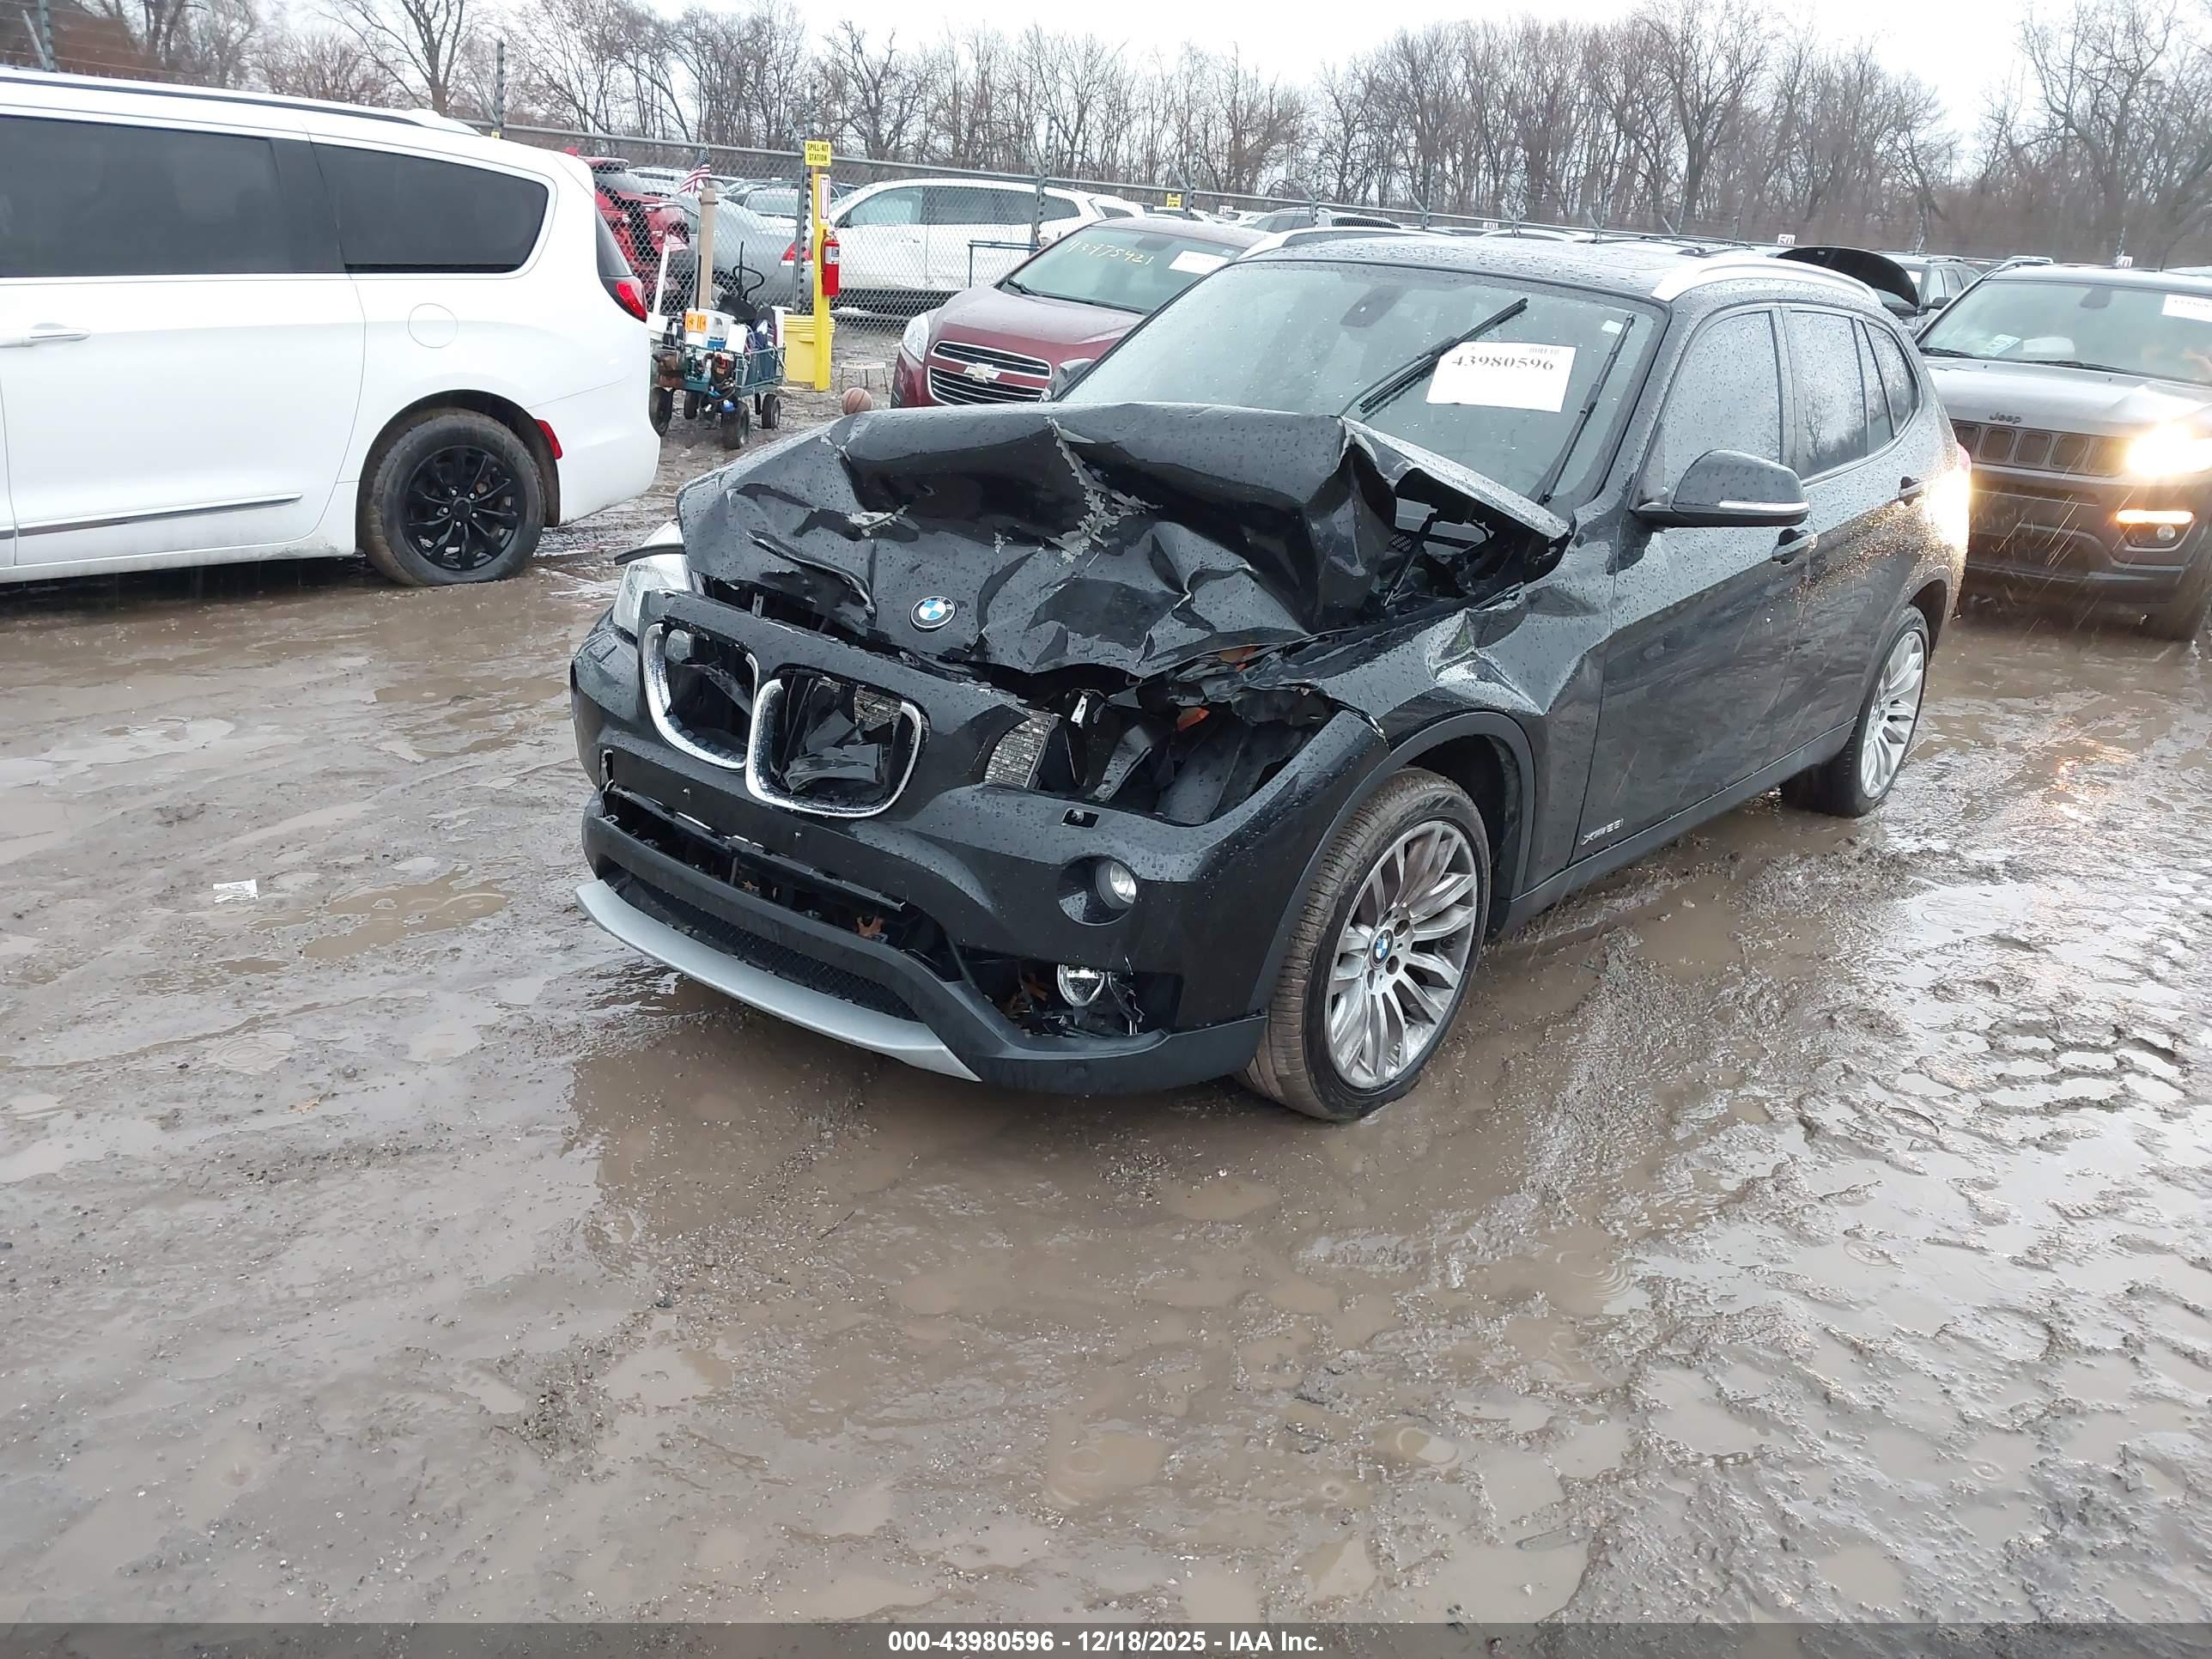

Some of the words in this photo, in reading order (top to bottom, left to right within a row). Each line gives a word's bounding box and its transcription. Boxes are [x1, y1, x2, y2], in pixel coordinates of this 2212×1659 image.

[807, 143, 829, 152] SPILL-KIT
[809, 153, 827, 161] STATION
[1451, 355, 1555, 371] 43980596
[1989, 412, 2021, 424] Jeep
